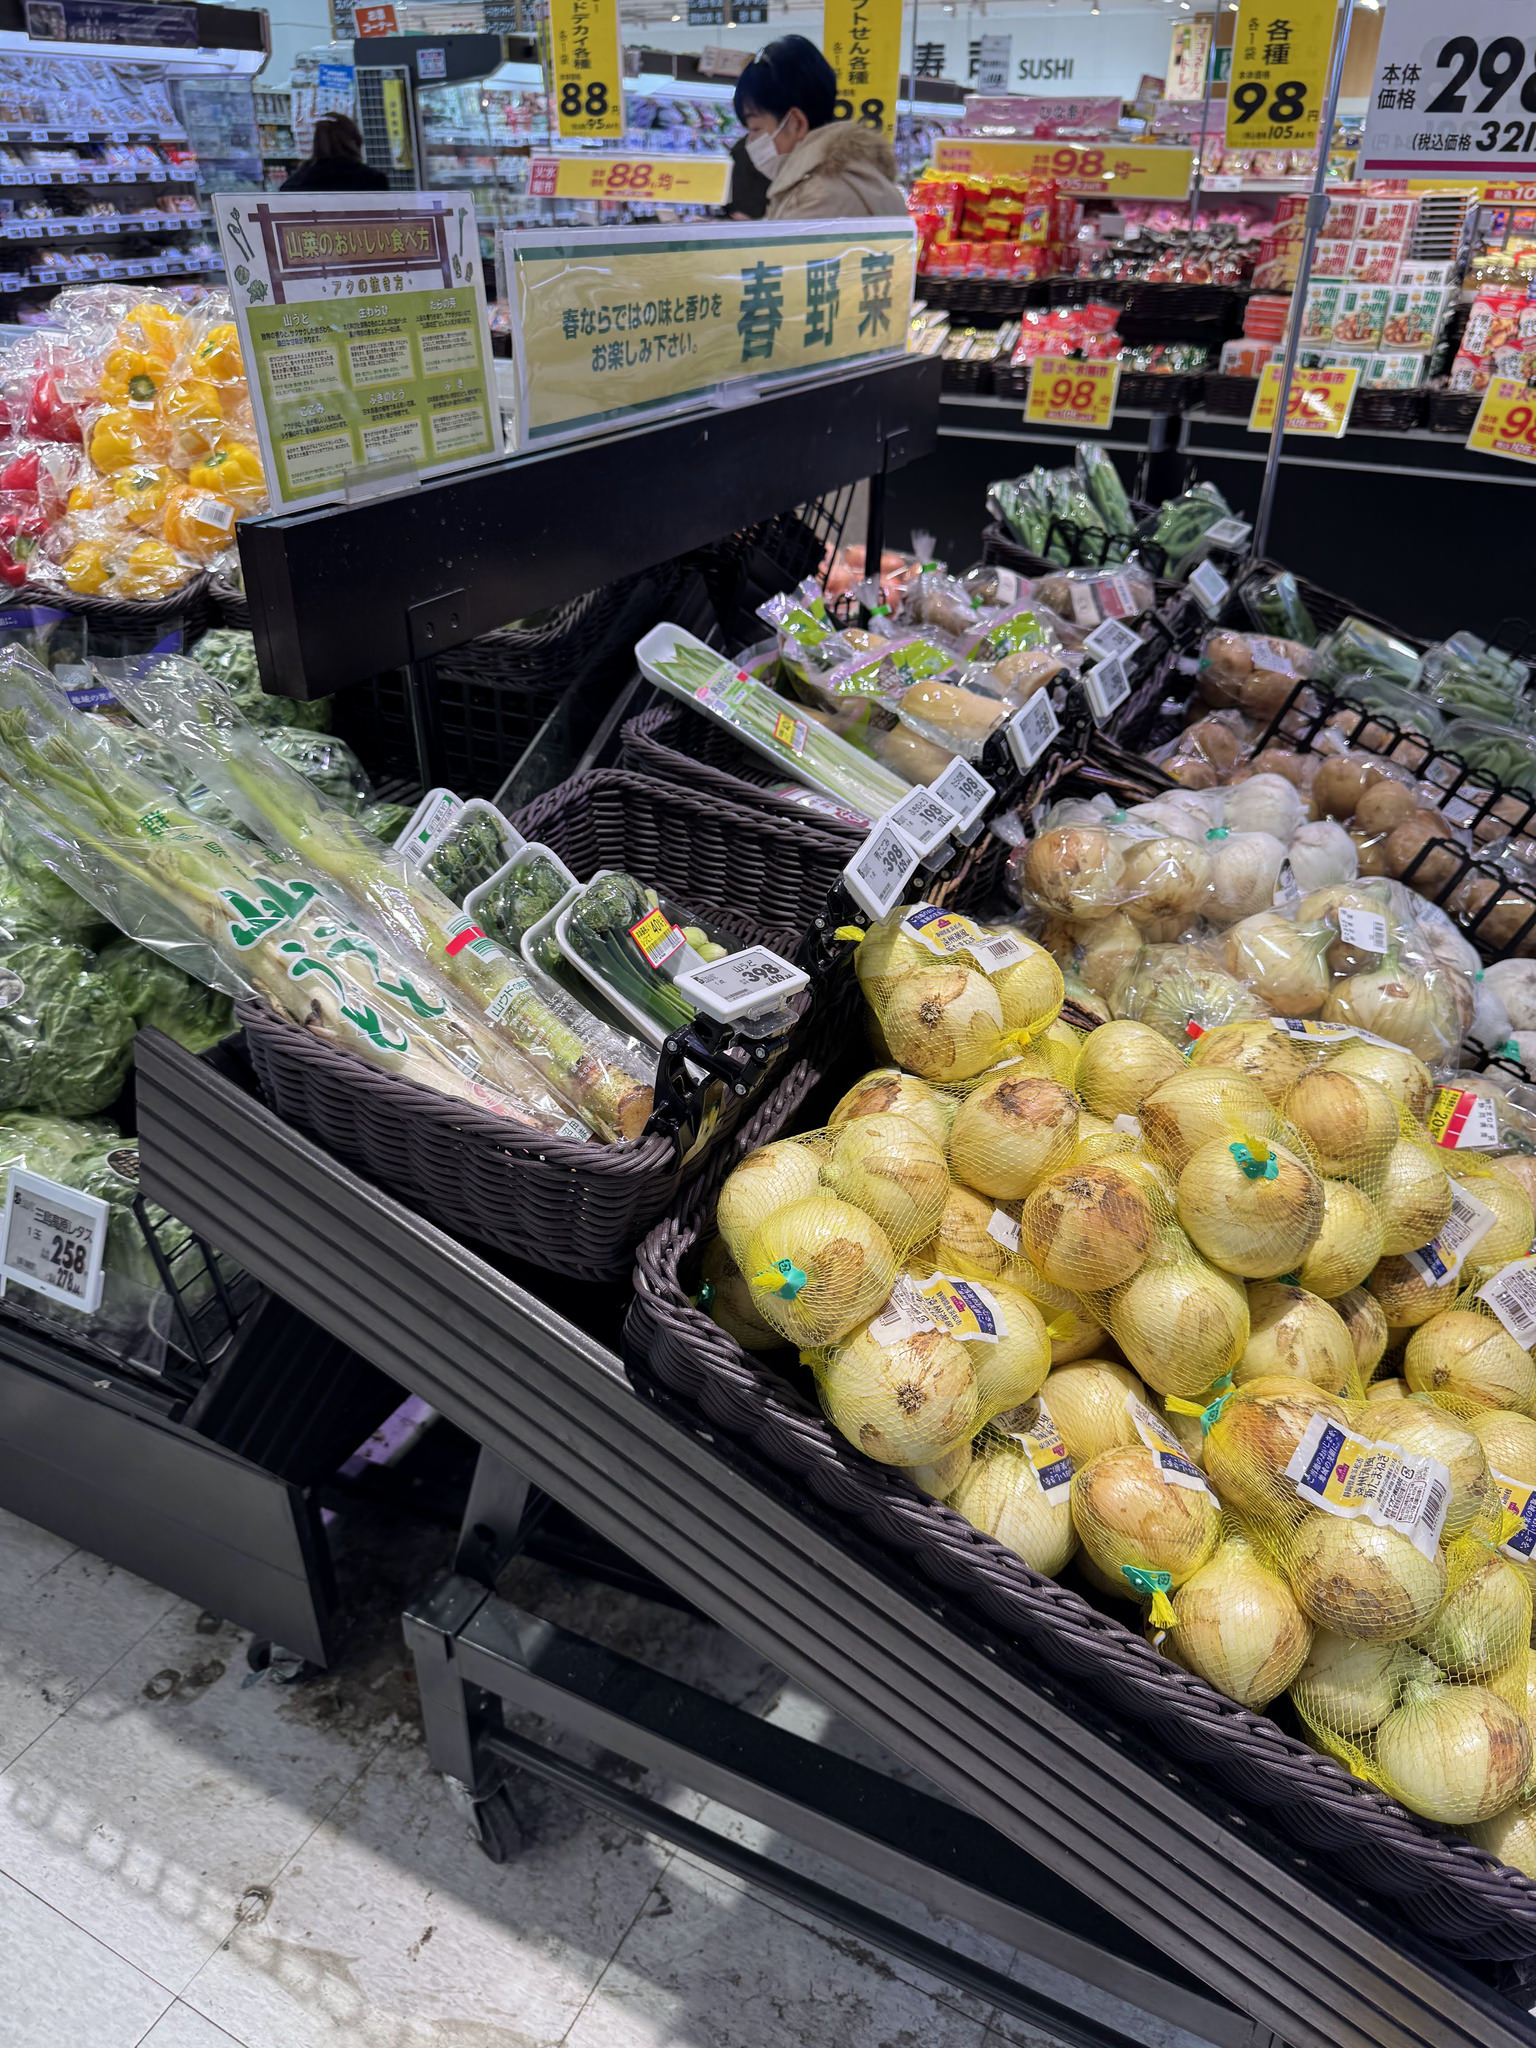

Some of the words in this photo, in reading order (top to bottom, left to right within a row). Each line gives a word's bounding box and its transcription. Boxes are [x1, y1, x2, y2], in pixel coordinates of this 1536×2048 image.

[1262, 19, 1294, 66] 各種
[1018, 58, 1074, 80] SUSHI
[1382, 64, 1423, 84] 本体
[561, 82, 608, 117] 88
[1234, 80, 1307, 124] 98
[1377, 89, 1417, 110] 価格
[606, 163, 653, 189] 88
[1052, 149, 1106, 178] 98
[286, 228, 432, 259] 山菜のおいしい食べ方
[561, 293, 723, 341] 春ならではの味と香りを
[736, 252, 895, 364] 春野菜
[591, 332, 700, 374] お楽しみ下さい。
[1050, 379, 1097, 408] 98
[918, 804, 943, 824] 198
[882, 843, 904, 873] 398
[731, 959, 758, 974] 山うど
[741, 963, 780, 982] 398
[50, 1234, 87, 1275] 258
